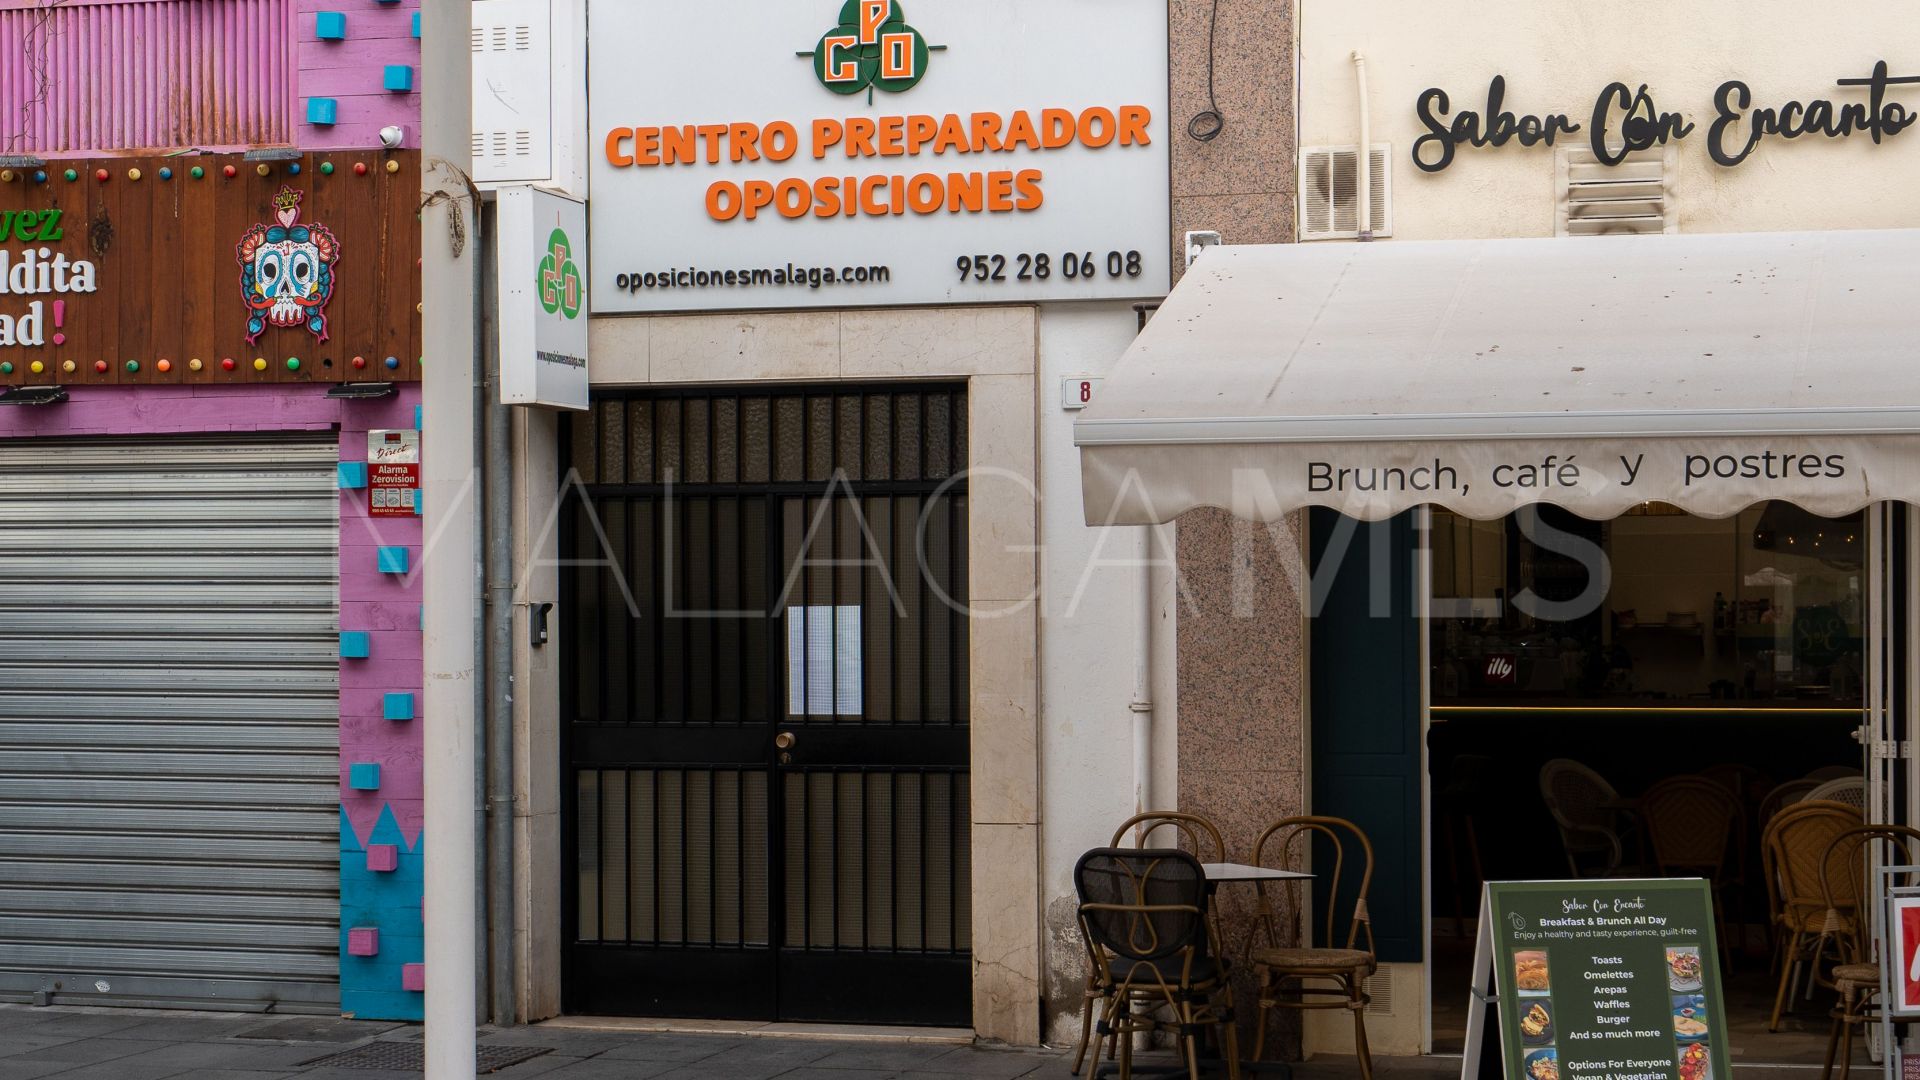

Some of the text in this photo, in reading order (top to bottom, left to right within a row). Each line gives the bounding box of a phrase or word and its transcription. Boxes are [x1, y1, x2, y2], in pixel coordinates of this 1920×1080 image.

[1411, 75, 1581, 173] Sabor
[1706, 60, 1920, 168] Encanto
[605, 105, 1152, 167] CENTRO PREPARADOR
[705, 169, 1044, 221] OPOSICIONES
[616, 250, 1143, 294] oposicionesmalaga.com 952 28 06 08
[1080, 381, 1091, 403] 8
[378, 465, 408, 474] Alarma
[1307, 450, 1846, 497] Brunch, café y postres
[372, 474, 415, 484] Zerovision
[1487, 657, 1512, 679] illy
[1562, 896, 1647, 914] Sabor Con Encanto
[1540, 916, 1667, 927] Breakfast & Brunch All Day
[1514, 931, 1536, 940] Enjoy
[1544, 930, 1574, 939] healthy
[1575, 930, 1591, 938] and
[1592, 930, 1613, 939] tasty
[1613, 929, 1659, 938] experience,
[1660, 927, 1697, 938] guilt-free
[1591, 956, 1623, 965] Toasts
[1583, 971, 1634, 980] Omelettes
[1593, 986, 1628, 996] Arepas
[1593, 1000, 1630, 1009] Waffles
[1596, 1015, 1630, 1025] Burger
[1569, 1031, 1590, 1040] And
[1605, 1030, 1633, 1039] much
[1635, 1030, 1661, 1038] more
[1568, 1059, 1672, 1071] Options For Everyone
[1614, 1071, 1668, 1080] Vegetarian
